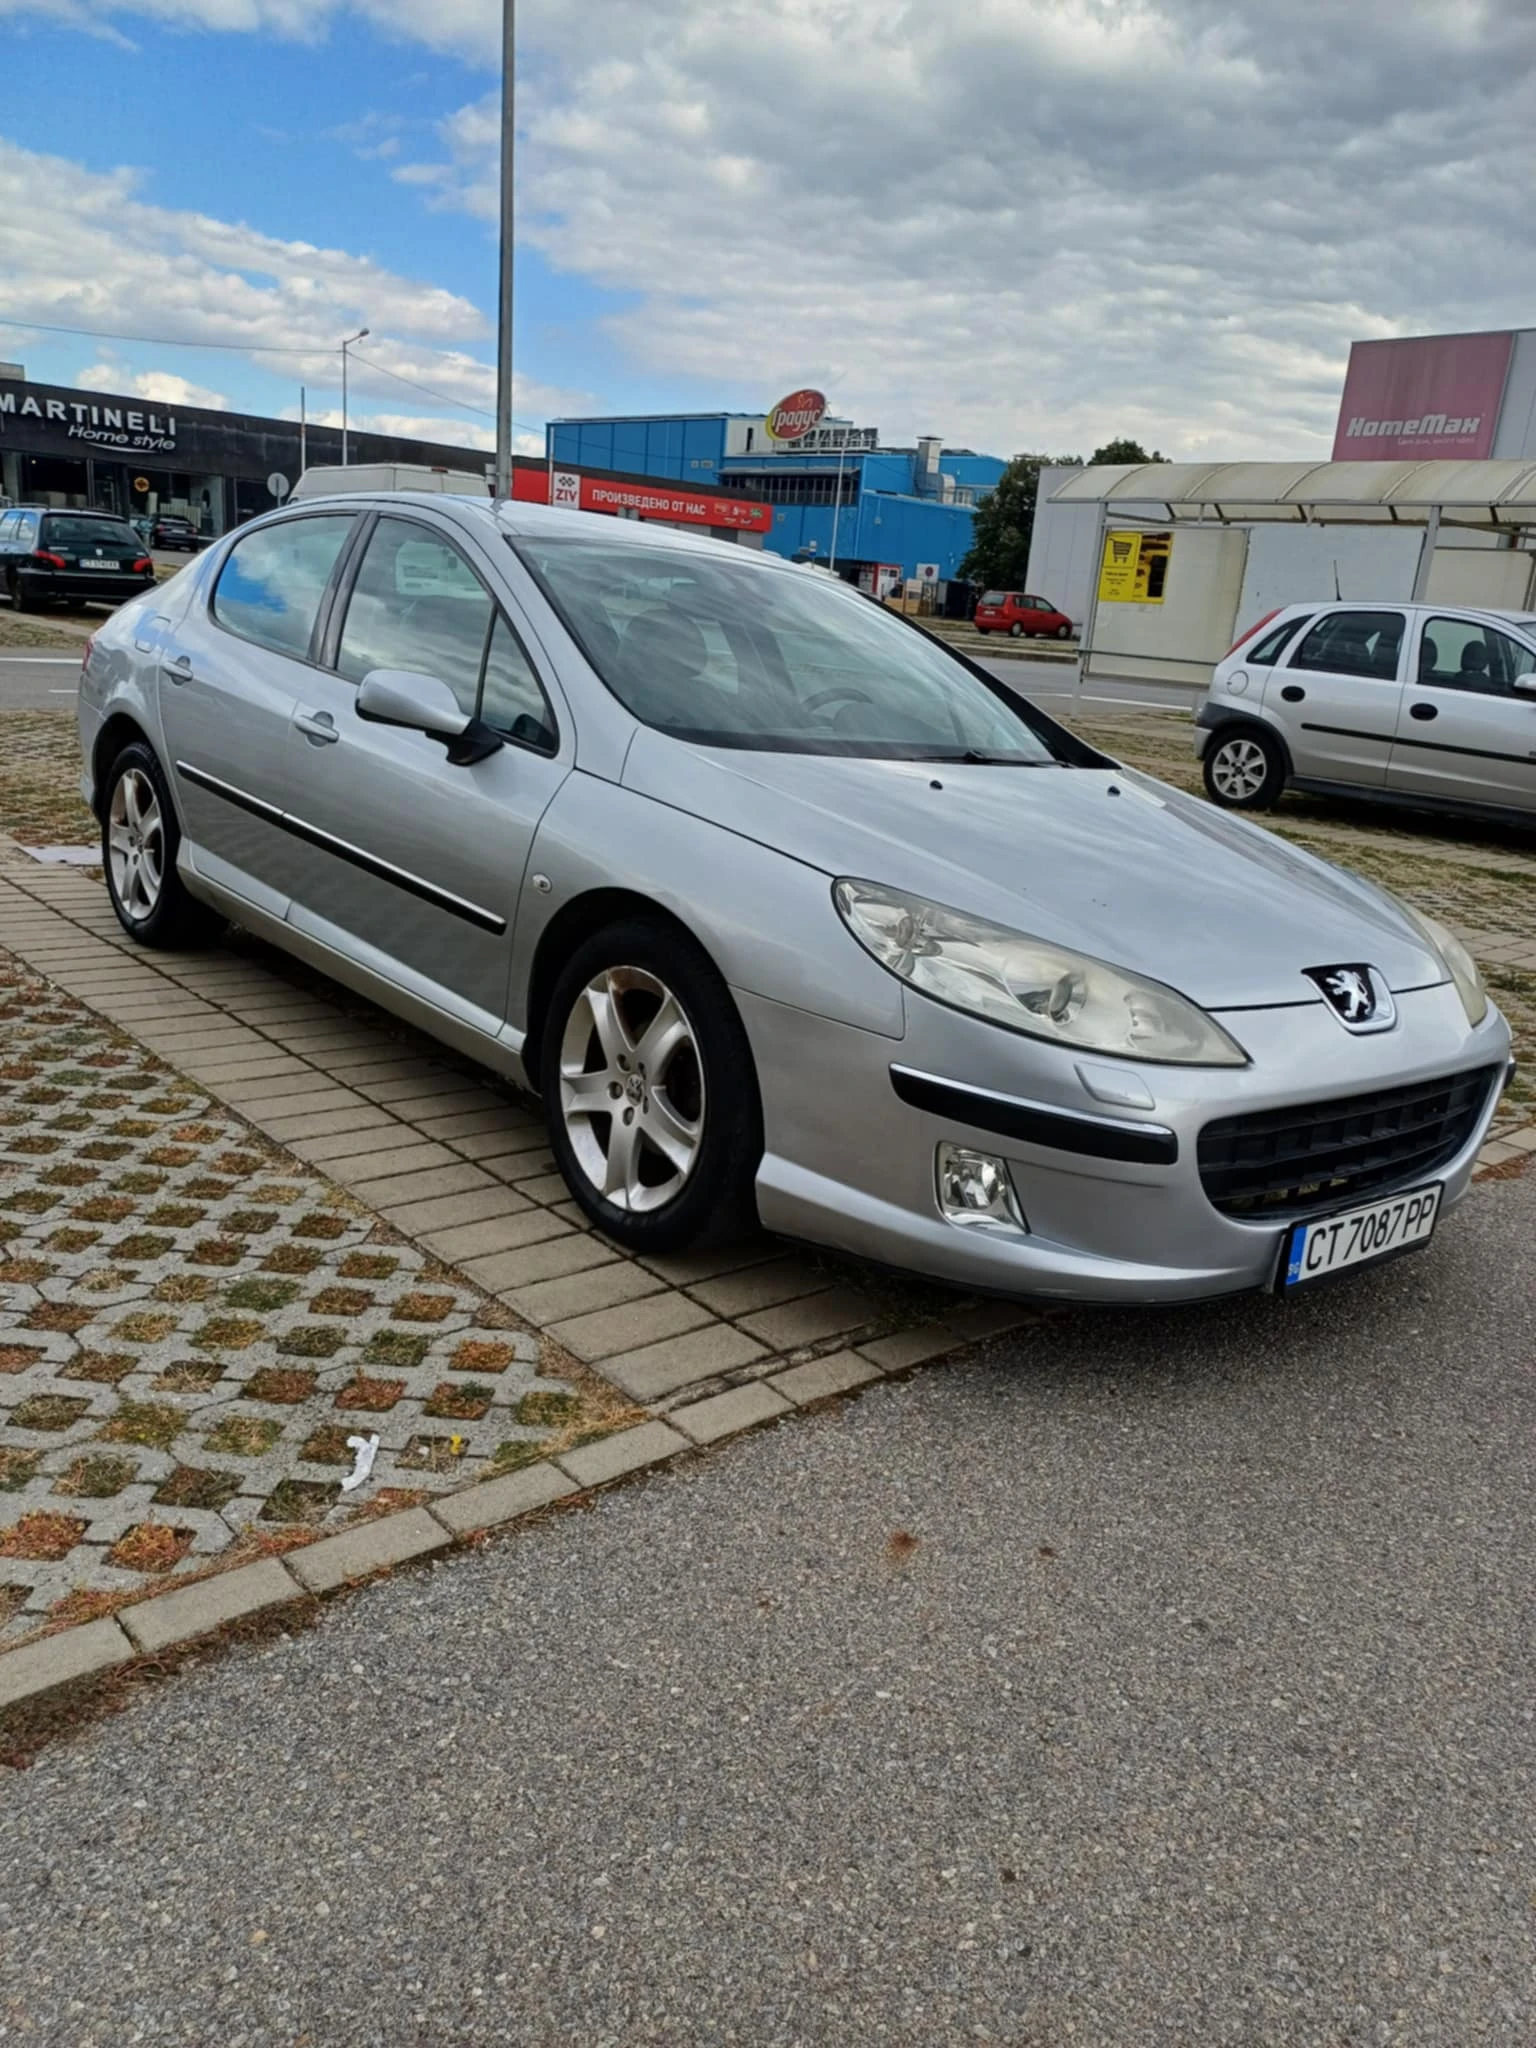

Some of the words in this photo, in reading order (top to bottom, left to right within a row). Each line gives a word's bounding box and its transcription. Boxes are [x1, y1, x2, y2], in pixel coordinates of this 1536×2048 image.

[0, 393, 177, 436] MARTINELI
[1346, 414, 1481, 437] HomeMax
[68, 424, 129, 444] Home
[133, 435, 176, 450] style
[556, 487, 578, 503] ZIV
[592, 488, 670, 511] ПРОИЗВЕДЕНО
[671, 501, 684, 512] ОТ
[685, 503, 706, 516] НАС
